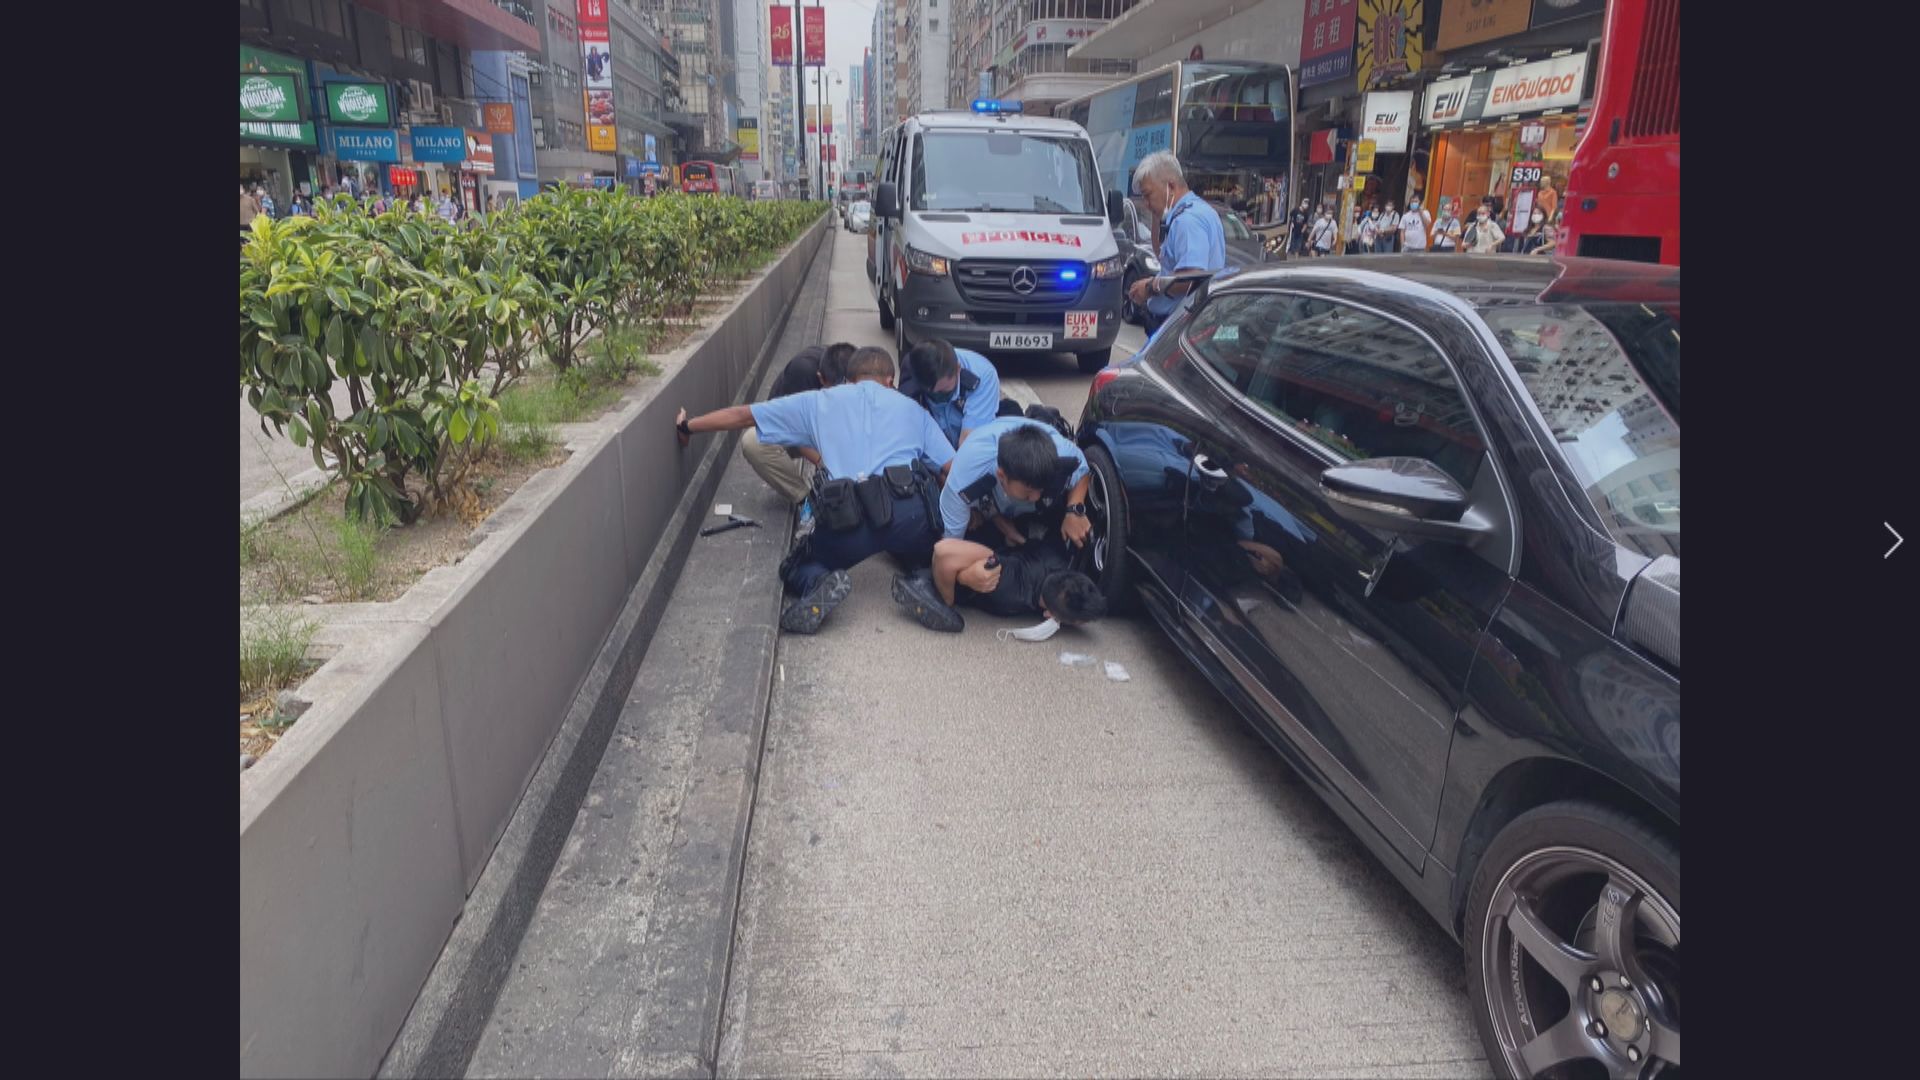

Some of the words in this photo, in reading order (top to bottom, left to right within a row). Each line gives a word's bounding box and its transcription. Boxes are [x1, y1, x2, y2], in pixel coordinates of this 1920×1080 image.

[1313, 15, 1341, 50] 招租
[1432, 84, 1465, 119] EW
[1375, 112, 1398, 125] EW
[339, 135, 393, 149] MILANO
[415, 136, 461, 148] MILANO
[1513, 167, 1541, 181] S30
[1066, 314, 1097, 326] EUKW
[1072, 326, 1089, 338] 22
[994, 335, 1011, 347] AM
[1015, 335, 1049, 347] 8693
[1512, 970, 1528, 1025] ADVAN
